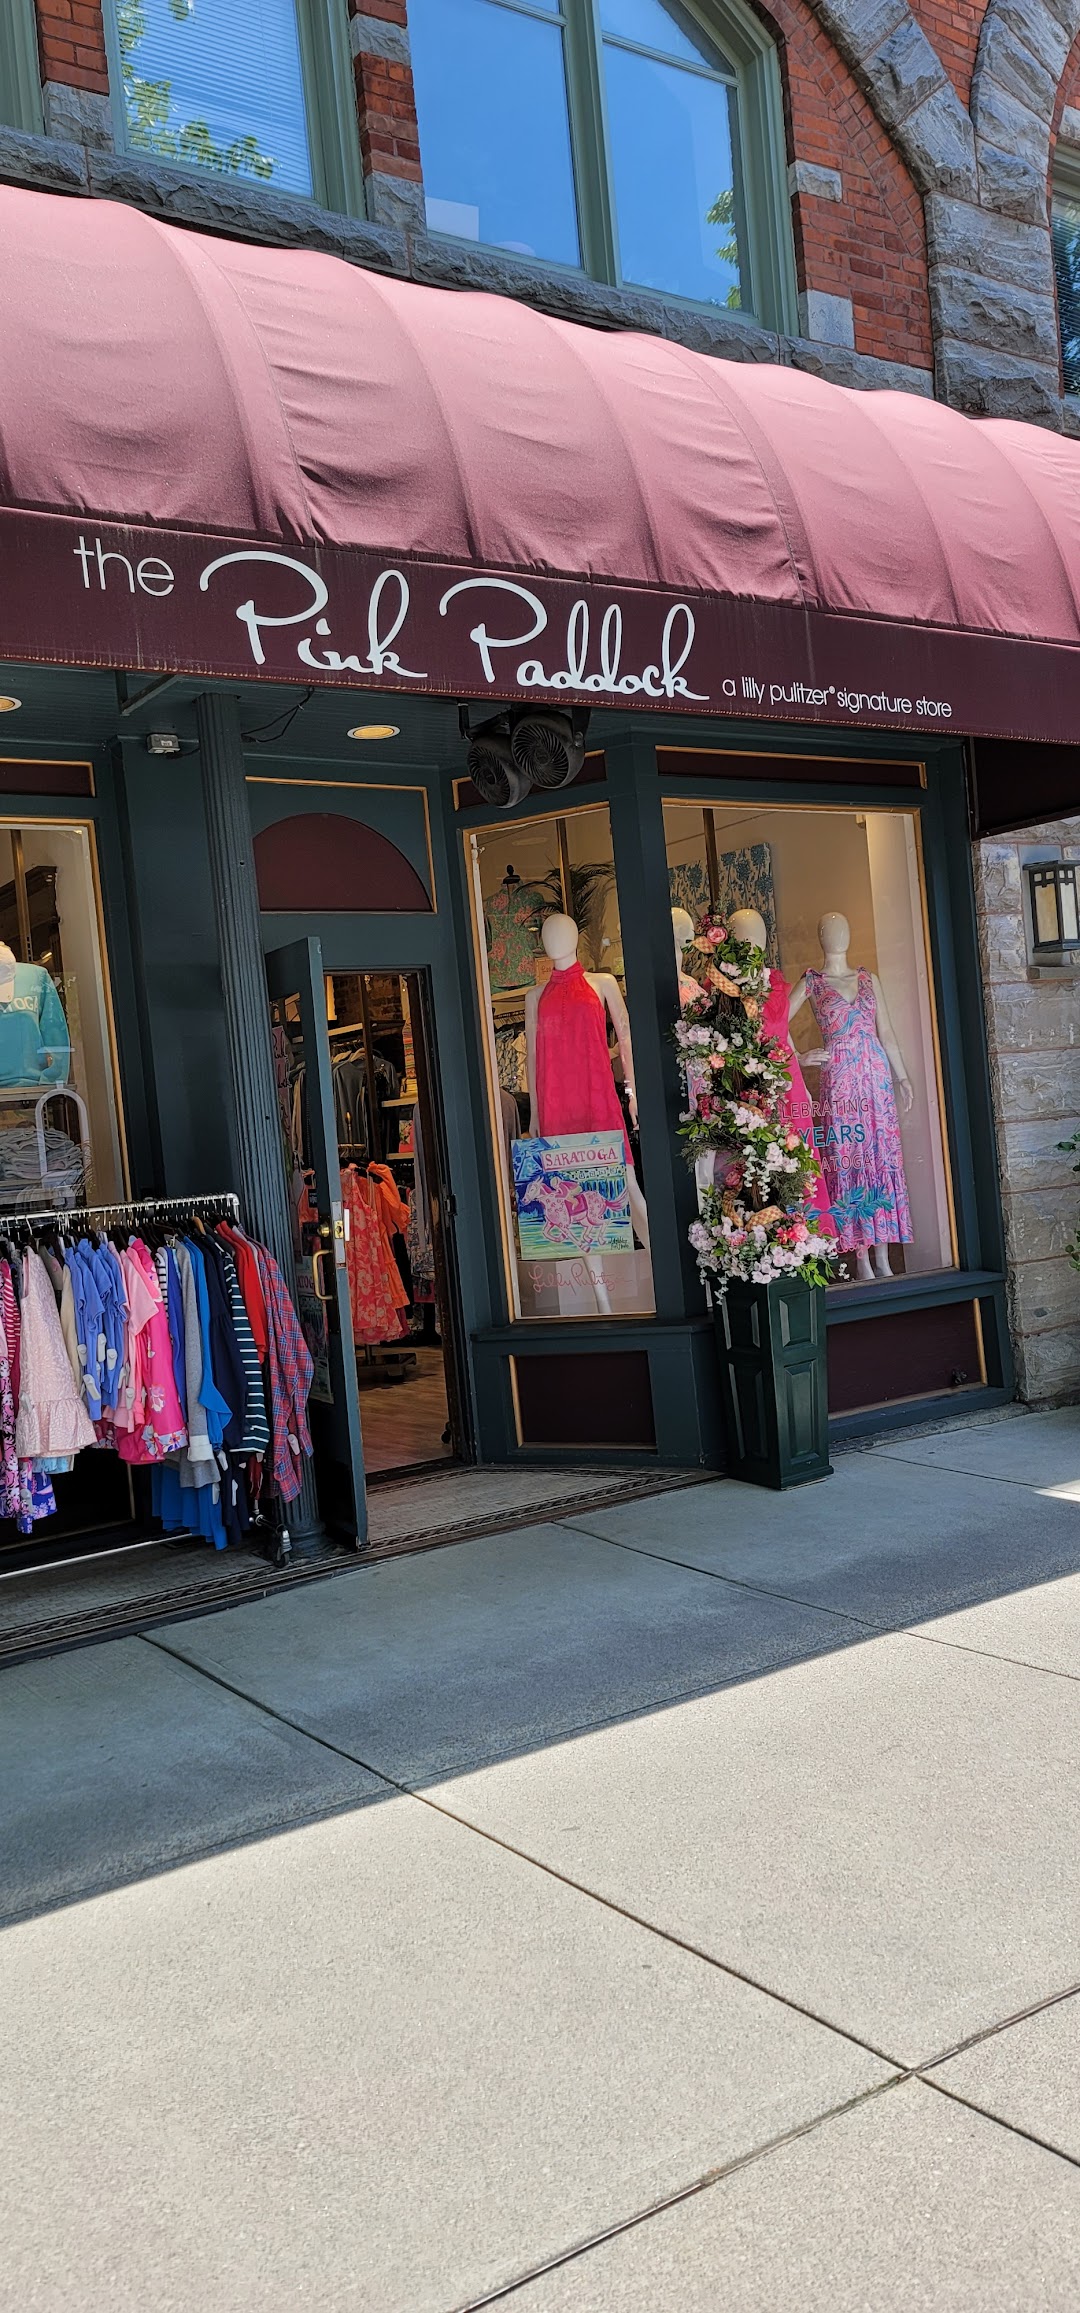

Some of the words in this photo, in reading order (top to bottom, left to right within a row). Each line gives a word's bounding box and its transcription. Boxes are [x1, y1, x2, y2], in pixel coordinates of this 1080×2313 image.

[73, 536, 174, 597] the
[200, 551, 428, 678] Pink
[439, 577, 710, 700] Paddock
[722, 679, 736, 697] a
[741, 676, 765, 704] lilly
[837, 687, 912, 714] signature
[916, 696, 952, 718] store
[781, 1097, 869, 1119] LEBRATING
[798, 1124, 866, 1147] YEARS
[544, 1147, 618, 1167] SARATOGA
[821, 1153, 873, 1173] ATOGA
